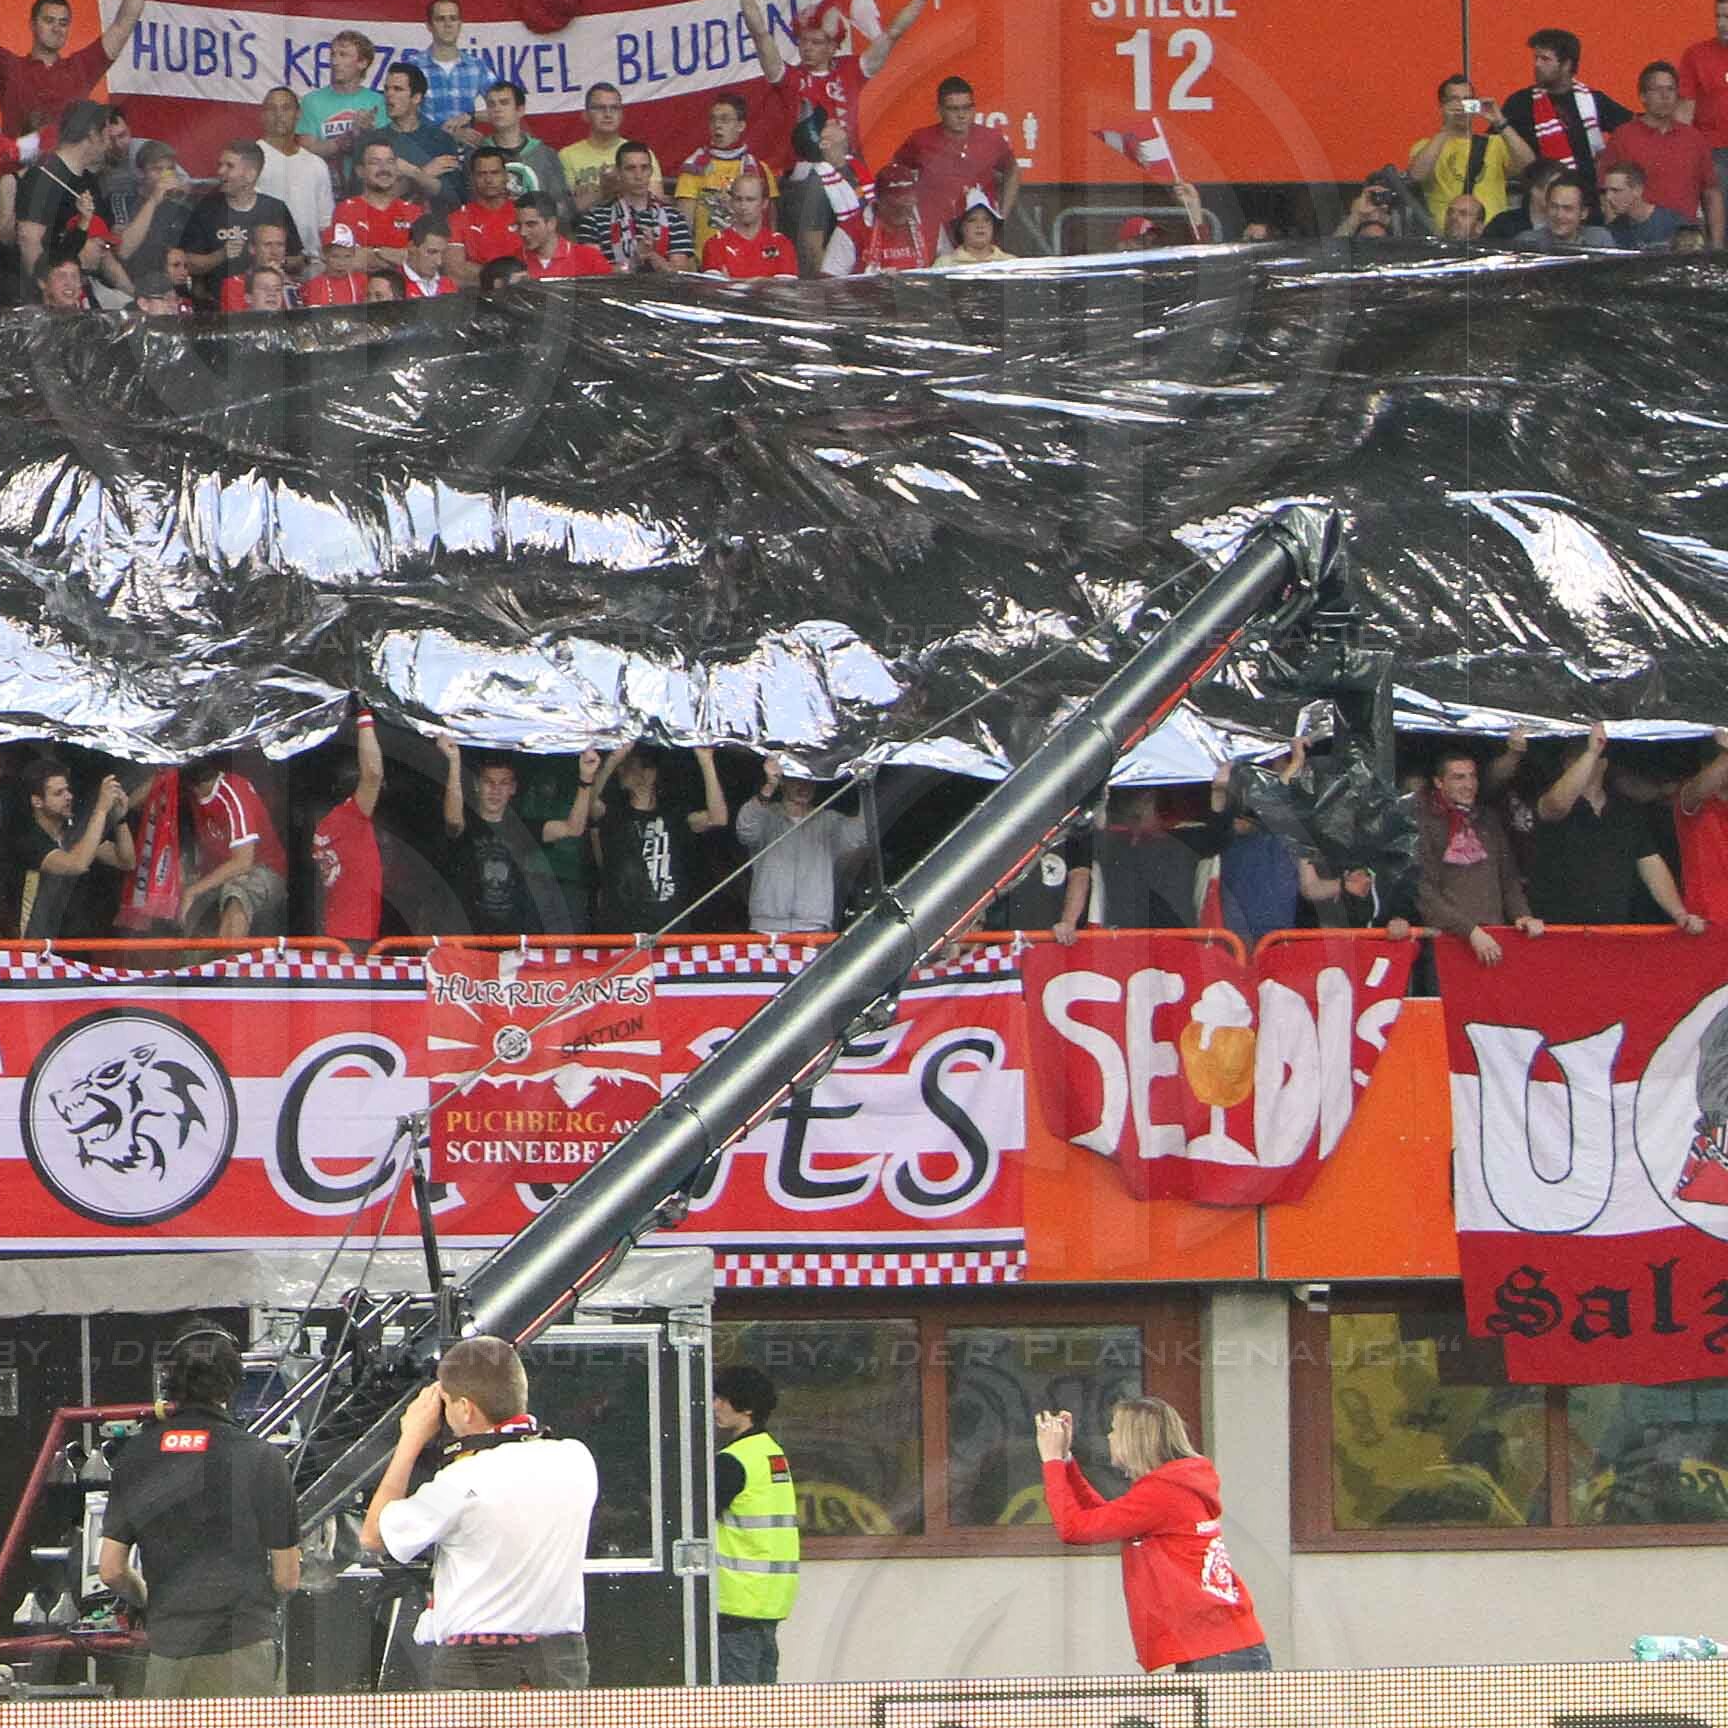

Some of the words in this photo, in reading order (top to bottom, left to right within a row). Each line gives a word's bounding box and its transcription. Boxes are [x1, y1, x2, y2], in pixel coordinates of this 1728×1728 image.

[1116, 28, 1214, 111] 12
[434, 975, 651, 1006] HURRICANES
[559, 1016, 645, 1059] SEKTION
[446, 1112, 607, 1134] PUCHBERG
[164, 1432, 208, 1448] ORF
